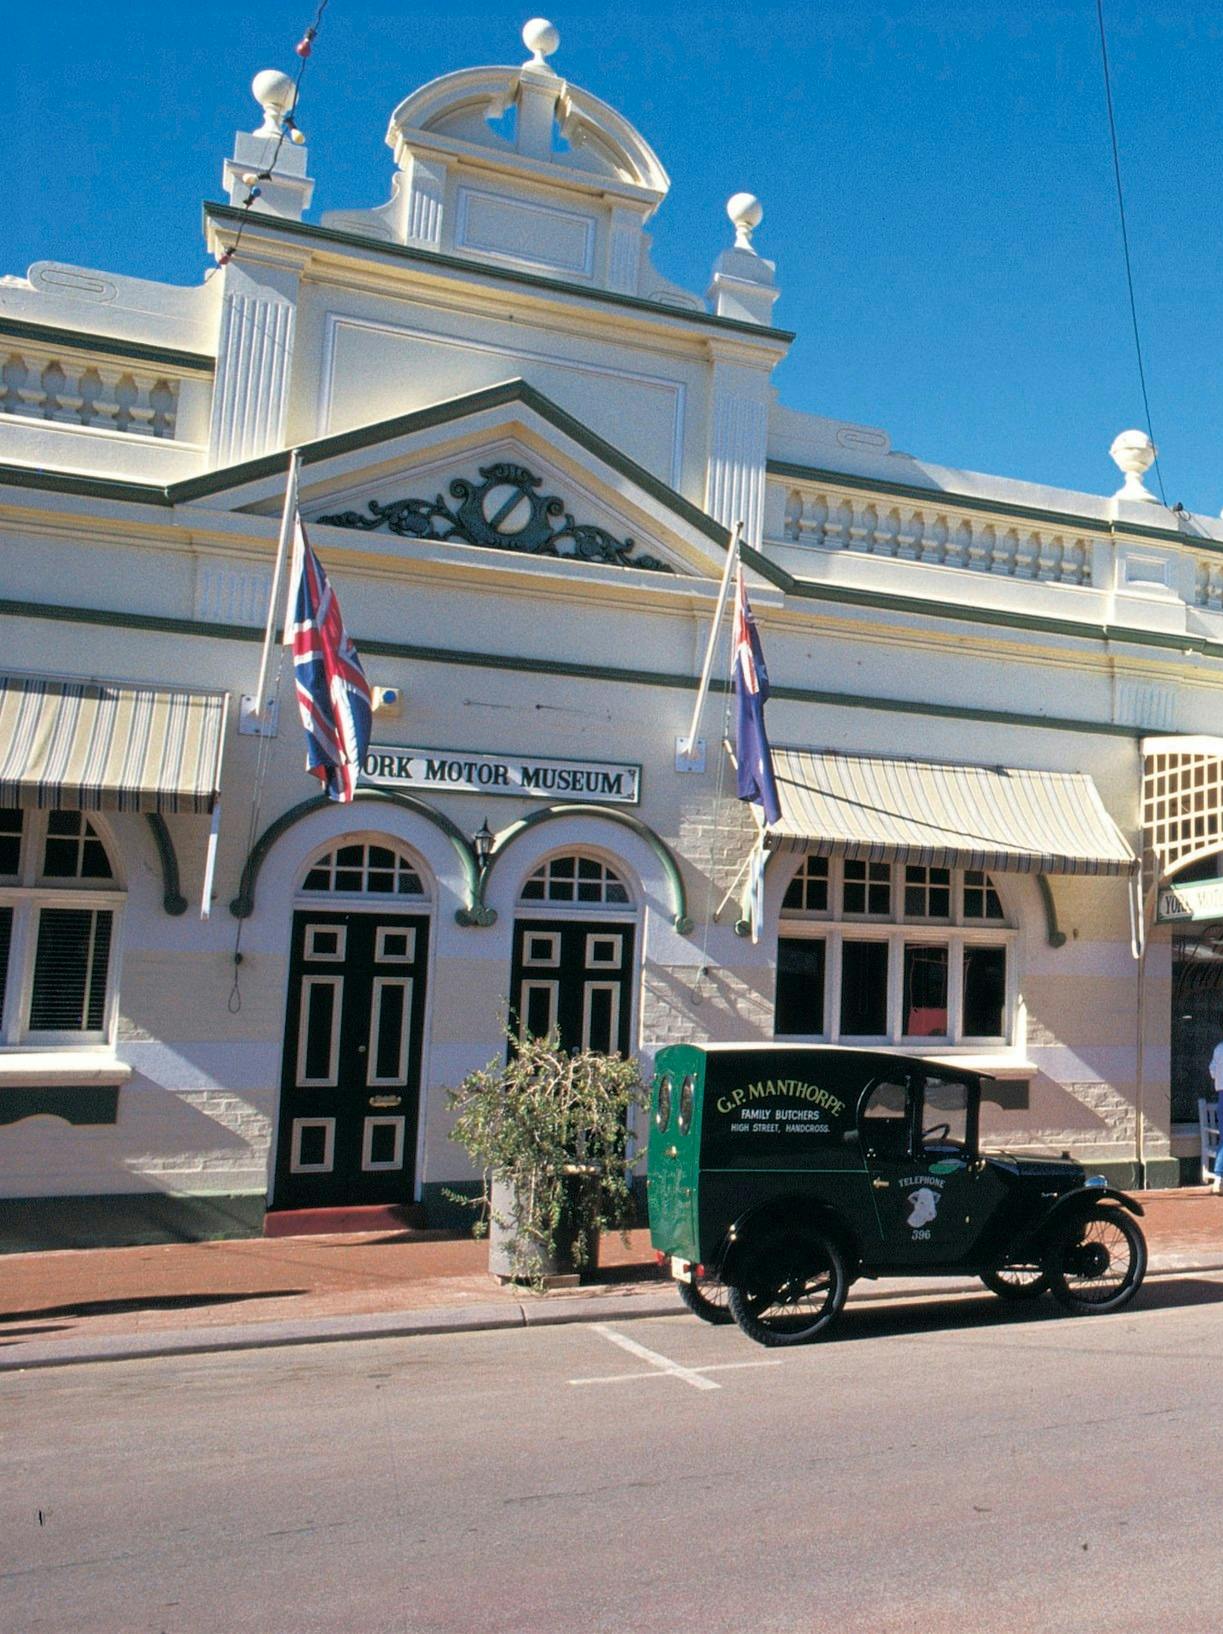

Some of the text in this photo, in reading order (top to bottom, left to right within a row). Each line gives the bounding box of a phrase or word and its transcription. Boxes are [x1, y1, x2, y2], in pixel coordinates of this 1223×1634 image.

[364, 753, 623, 795] ORK MOTOR MUSEUM
[749, 1079, 846, 1118] MANTHORPE
[741, 1108, 820, 1121] FAMILY BUTCHERS
[731, 1123, 750, 1133] HIGH
[752, 1123, 781, 1134] STREET,
[898, 1175, 946, 1189] TELEPHONE
[911, 1229, 931, 1241] 396
